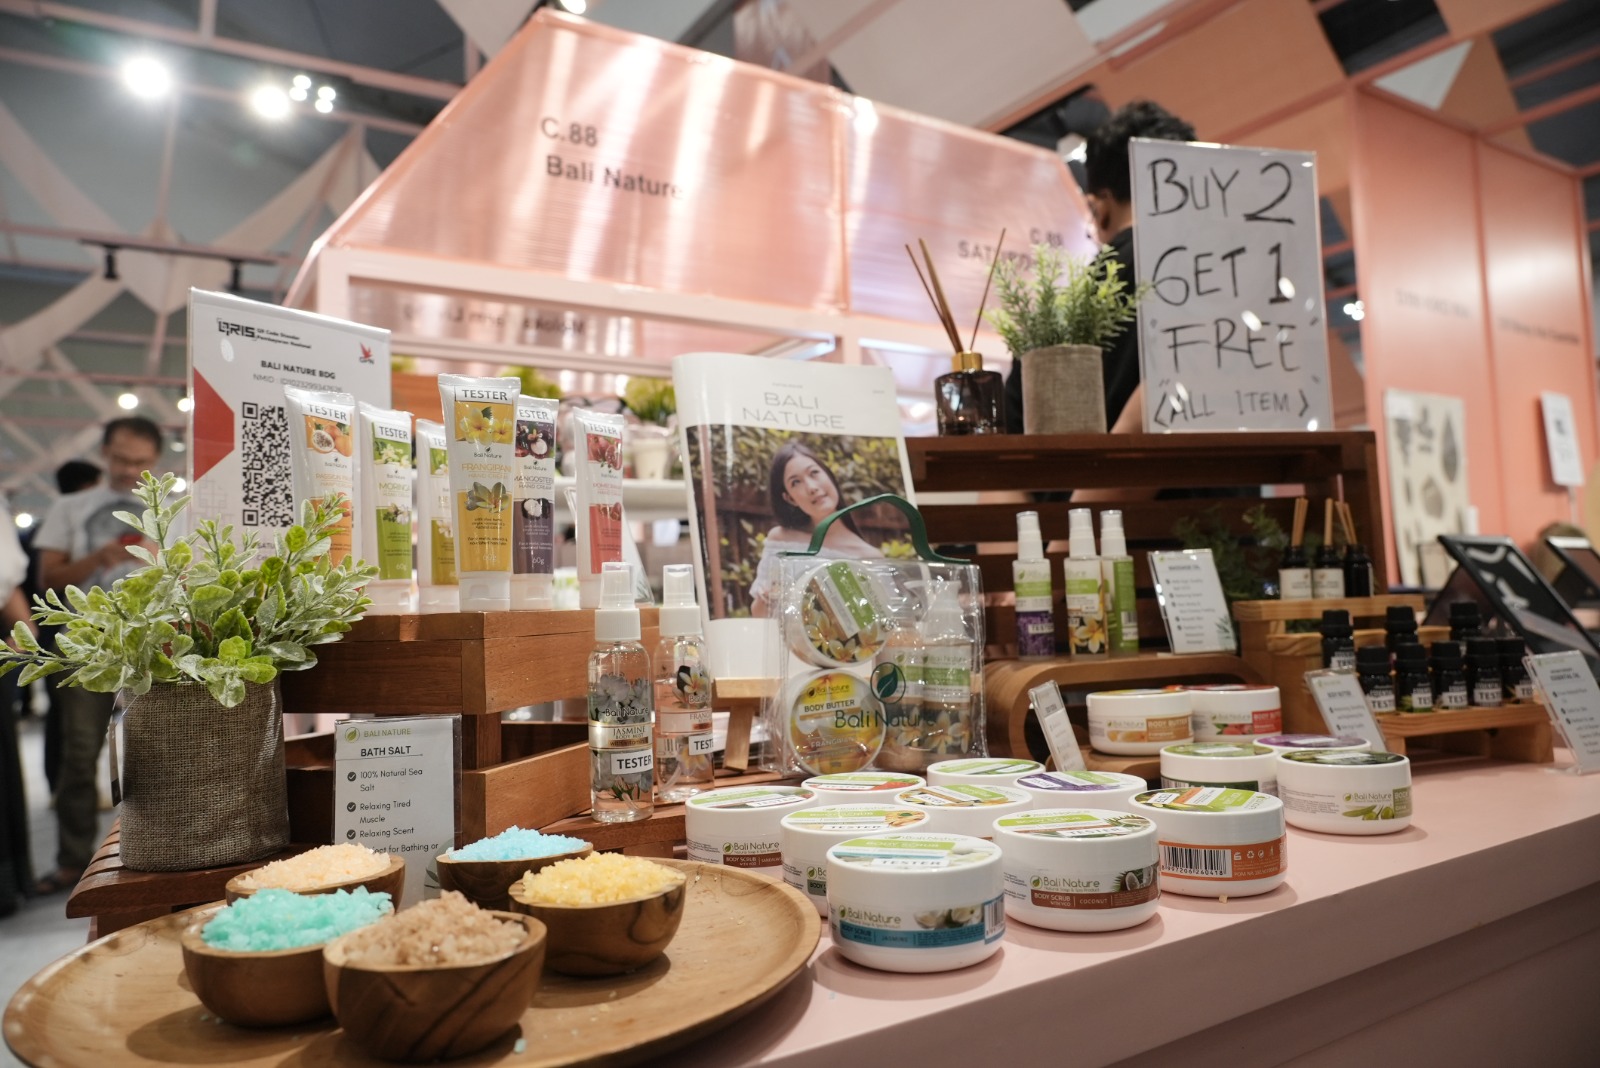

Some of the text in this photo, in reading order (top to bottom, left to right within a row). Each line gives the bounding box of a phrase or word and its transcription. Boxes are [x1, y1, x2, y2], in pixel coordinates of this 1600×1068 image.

[541, 116, 598, 147] C.88
[546, 155, 683, 199] Bali Nature
[1147, 157, 1296, 225] BUY 2
[1151, 242, 1296, 306] GET 1
[261, 360, 336, 380] BALI NATURE BDG
[462, 389, 508, 401] TESTER
[764, 392, 820, 410] BALI
[308, 404, 347, 421] TESTER
[518, 409, 550, 420] ESTER
[742, 407, 846, 430] NATURE
[378, 426, 408, 440] TESTER
[589, 423, 618, 435] TESTER
[532, 556, 544, 565] 60g
[804, 699, 855, 712] BODY BUTTER
[605, 706, 648, 718] Bali Nature
[835, 710, 937, 728] Bali Nature
[364, 728, 412, 738] BALI NATURE
[360, 746, 412, 757] BATH SALT
[360, 768, 423, 778] 100% Natural Sea
[360, 784, 375, 792] Salt
[360, 800, 411, 811] Relaxing Tired
[360, 816, 386, 824] Muscle
[360, 827, 414, 838] Relaxing Scent
[1070, 827, 1120, 836] TESTER
[402, 844, 429, 854] Bathing
[734, 842, 780, 850] Bali Nature
[1044, 876, 1100, 888] Bali Nature
[848, 908, 901, 922] Bali Nature
